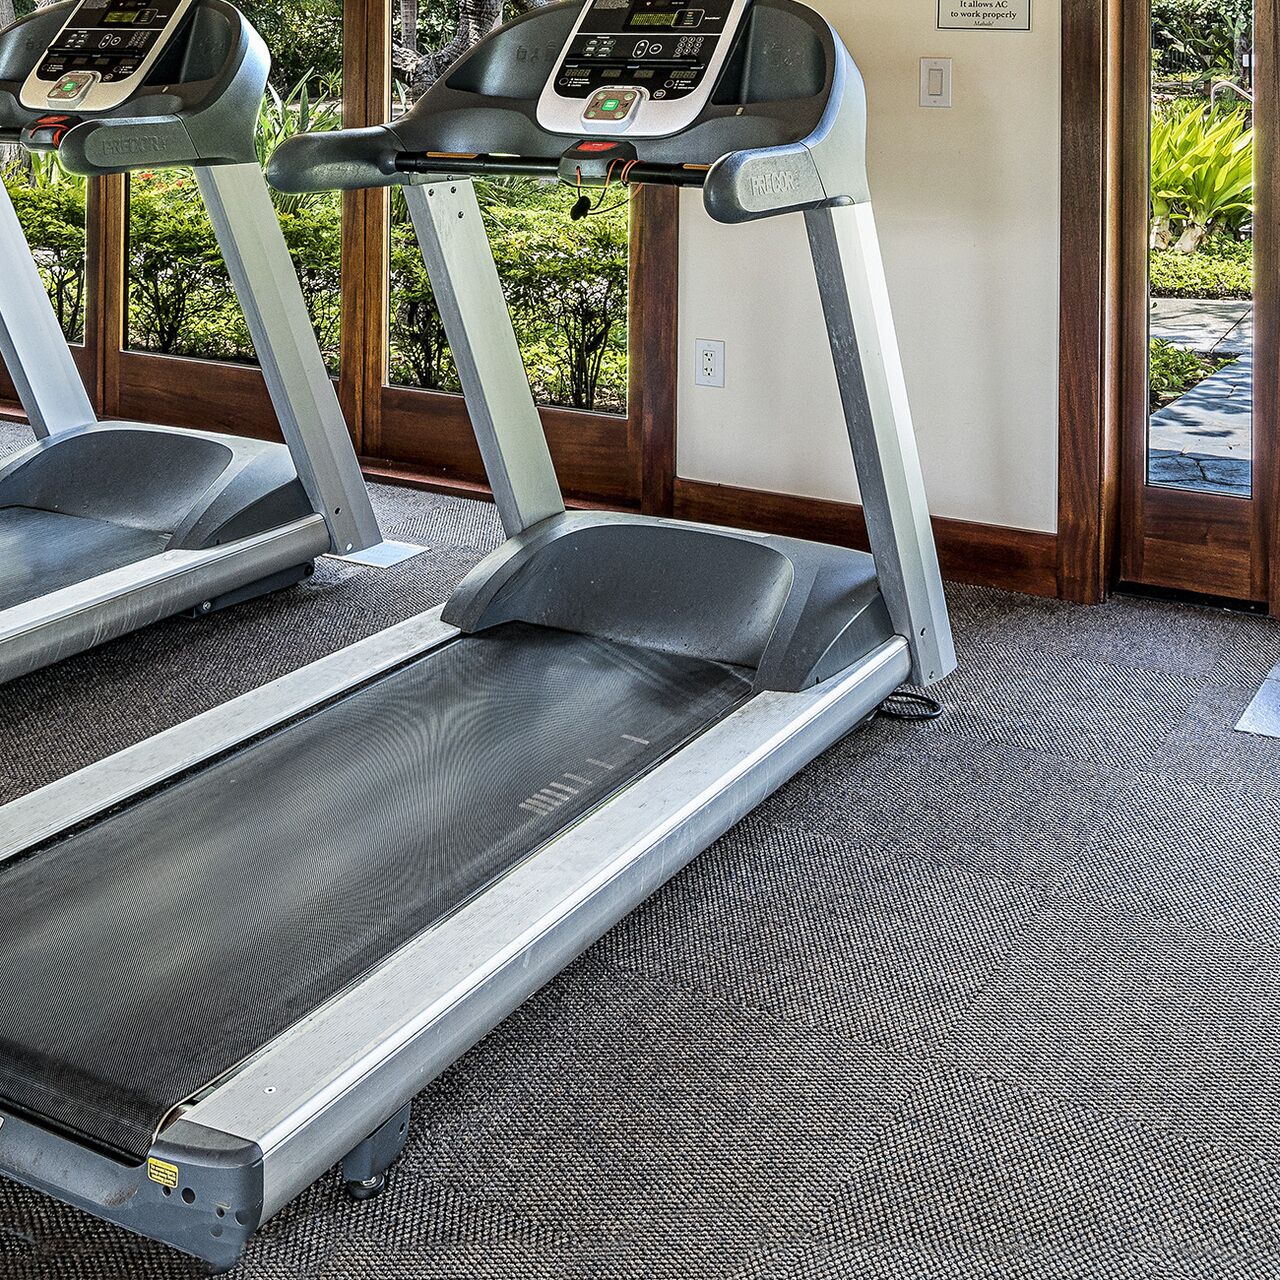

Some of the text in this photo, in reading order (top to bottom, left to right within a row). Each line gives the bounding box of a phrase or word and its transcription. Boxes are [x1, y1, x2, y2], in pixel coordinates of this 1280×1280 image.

[960, 0, 1008, 8] It allows AC
[982, 11, 1017, 20] properly
